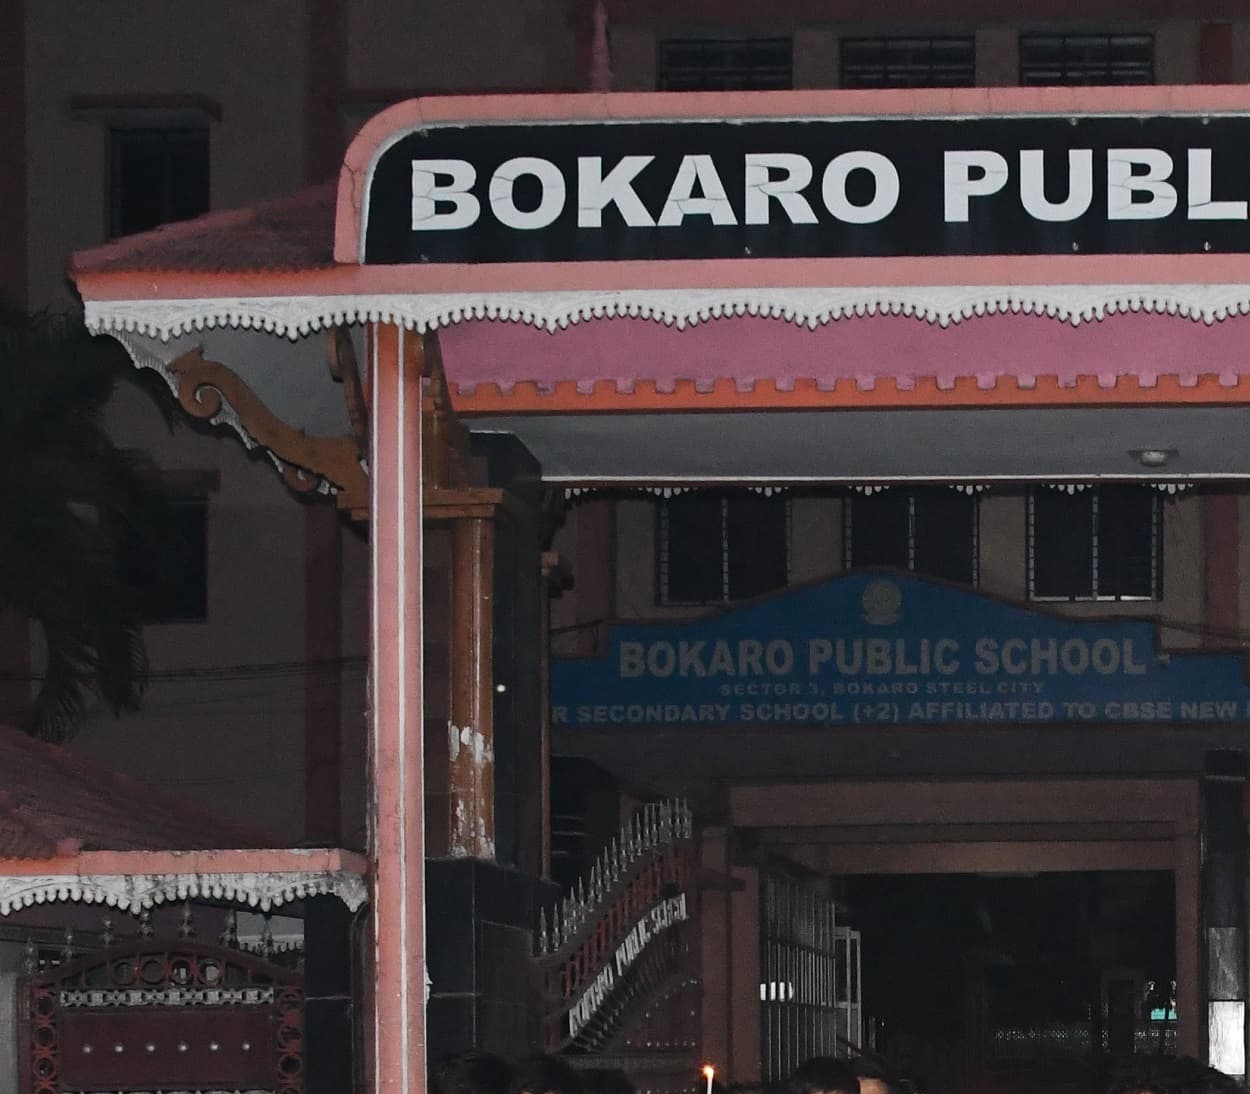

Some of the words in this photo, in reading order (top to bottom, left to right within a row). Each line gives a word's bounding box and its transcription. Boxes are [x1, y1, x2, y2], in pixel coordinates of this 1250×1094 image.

[411, 150, 900, 231] BOKARO
[620, 640, 794, 678] BOKARO
[809, 638, 960, 675] PUBLIC
[974, 638, 1147, 675] SCHOOL
[832, 682, 918, 695] BOKARO
[996, 681, 1045, 694] CITY
[575, 704, 732, 723] SECONDARY
[739, 703, 844, 722] SCHOOL
[908, 701, 1055, 721] AFFILIATED
[1066, 702, 1096, 719] TO
[1104, 702, 1171, 720] CBSE
[1180, 702, 1237, 720] NEW
